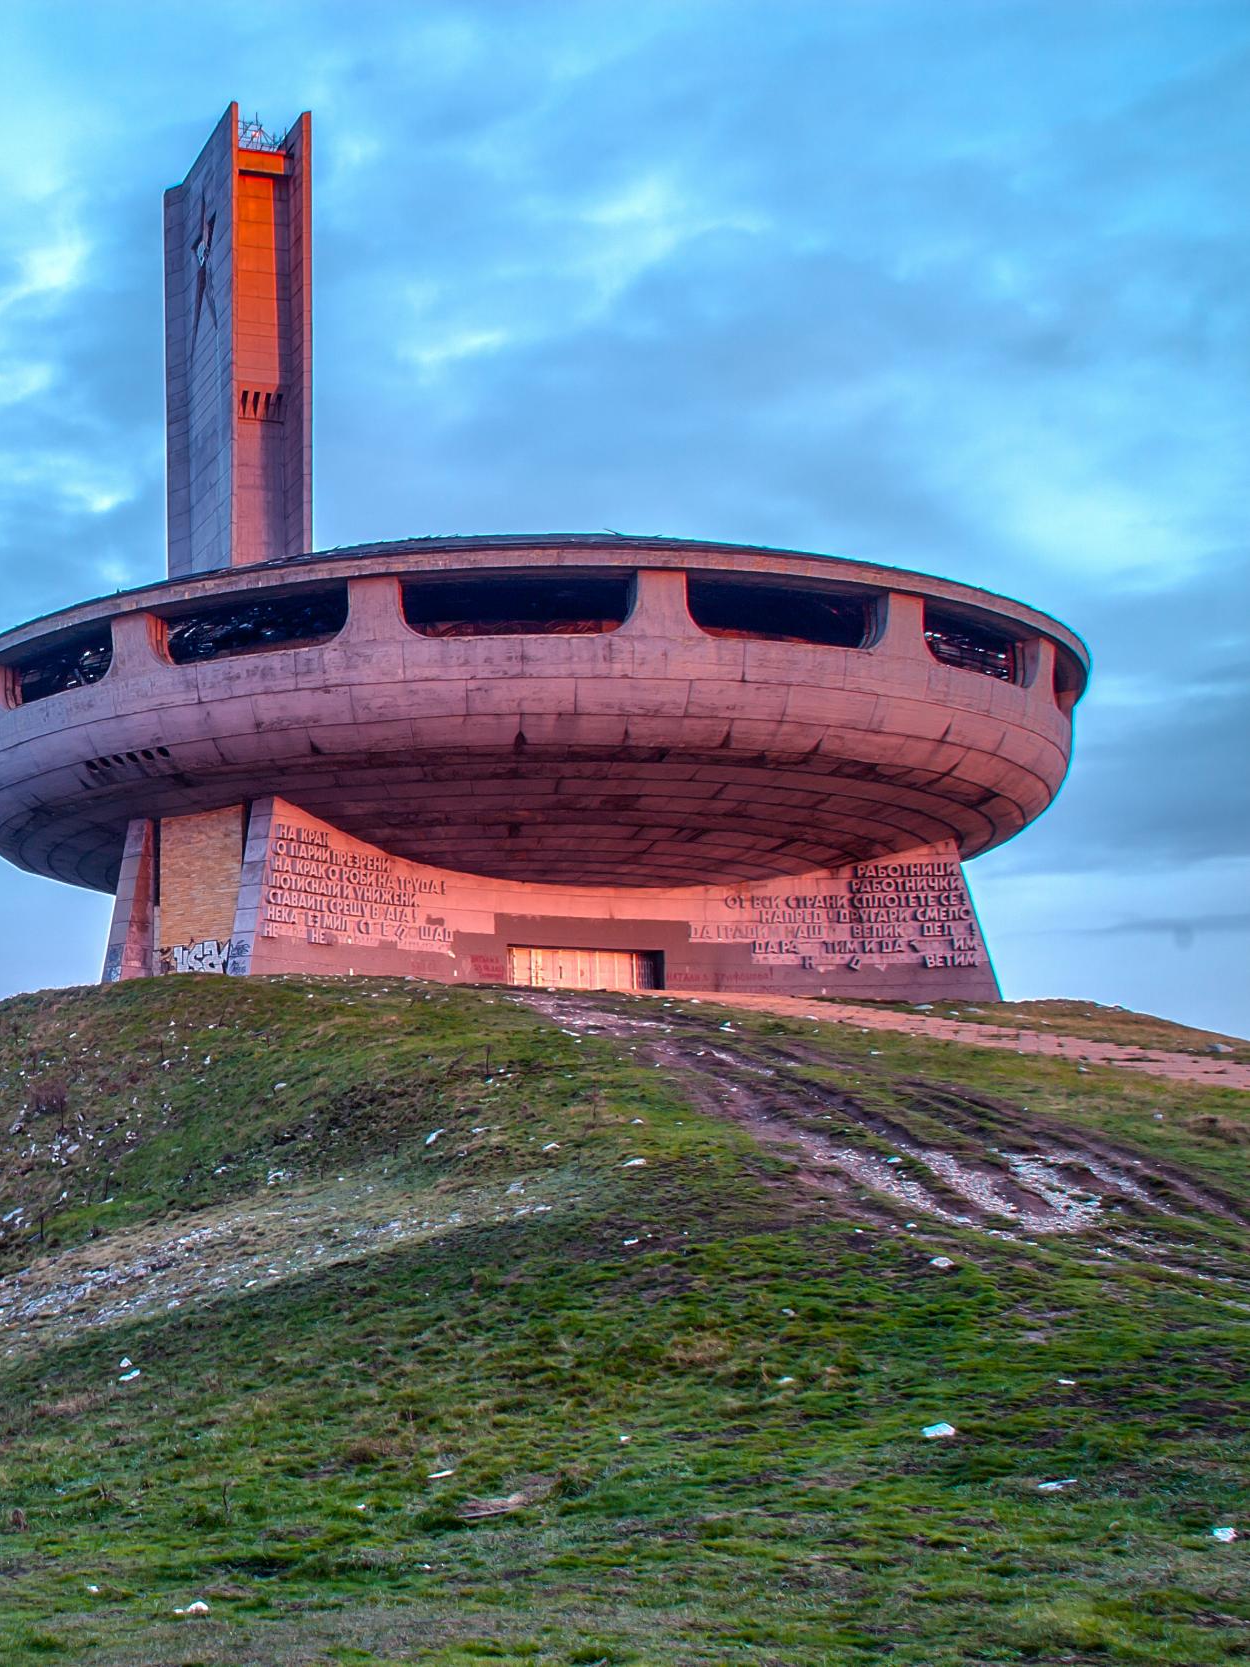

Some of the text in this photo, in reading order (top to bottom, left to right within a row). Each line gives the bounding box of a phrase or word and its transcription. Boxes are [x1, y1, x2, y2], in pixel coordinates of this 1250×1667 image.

[276, 824, 297, 841] НА
[273, 841, 287, 855] О
[272, 857, 292, 873] НА
[294, 860, 327, 879] КРАК
[327, 867, 340, 881] О
[340, 868, 375, 887] РОБИ
[376, 872, 396, 889] НА
[271, 873, 340, 898] ПОТИСНАТИ
[340, 884, 351, 900] И
[726, 896, 746, 909] ОТ
[751, 896, 781, 909] ВСИ
[785, 895, 847, 910] СТРАНИ
[851, 892, 936, 908] СПЛОТЕТЕ
[266, 906, 297, 924] НЕКА
[760, 909, 823, 923] НАПРЕД
[838, 908, 910, 923] ДРУГАРИ
[913, 906, 971, 921] СМЕЛО
[690, 924, 713, 939] ДА
[753, 940, 778, 954] ДА
[880, 938, 905, 953] ДА
